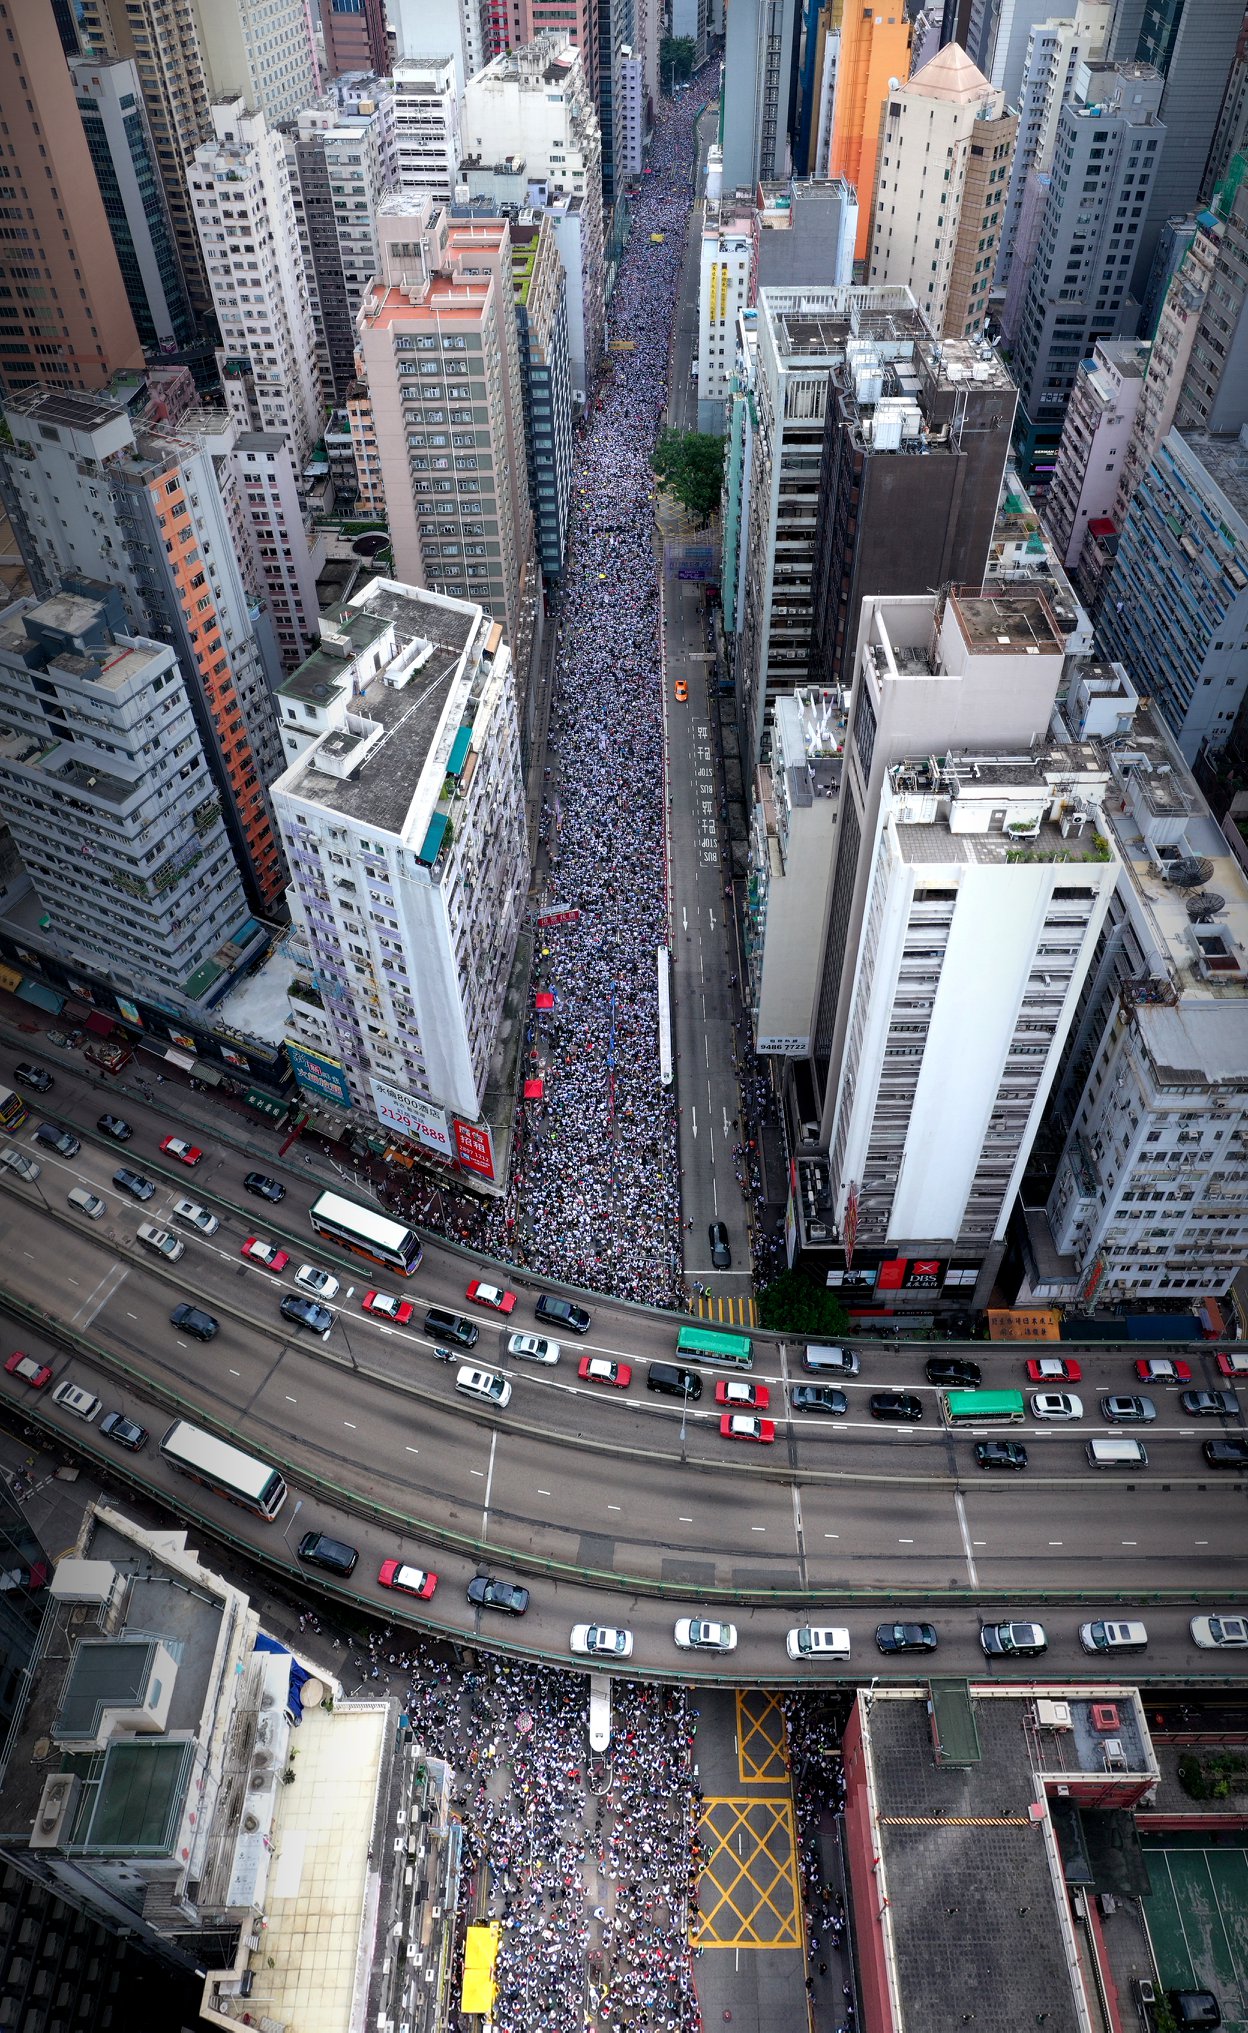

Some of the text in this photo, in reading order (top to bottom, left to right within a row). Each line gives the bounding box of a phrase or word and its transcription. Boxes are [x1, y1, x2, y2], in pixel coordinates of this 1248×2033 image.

[697, 746, 711, 760] 巴士
[698, 768, 713, 777] STOP
[700, 785, 713, 793] BUS
[702, 801, 713, 815] 站
[701, 819, 716, 834] 巴士
[701, 838, 718, 848] STOP
[703, 852, 718, 862] BUS
[380, 1105, 446, 1143] 2129 7888
[460, 1134, 486, 1153] 招租
[909, 1274, 938, 1282] DBS
